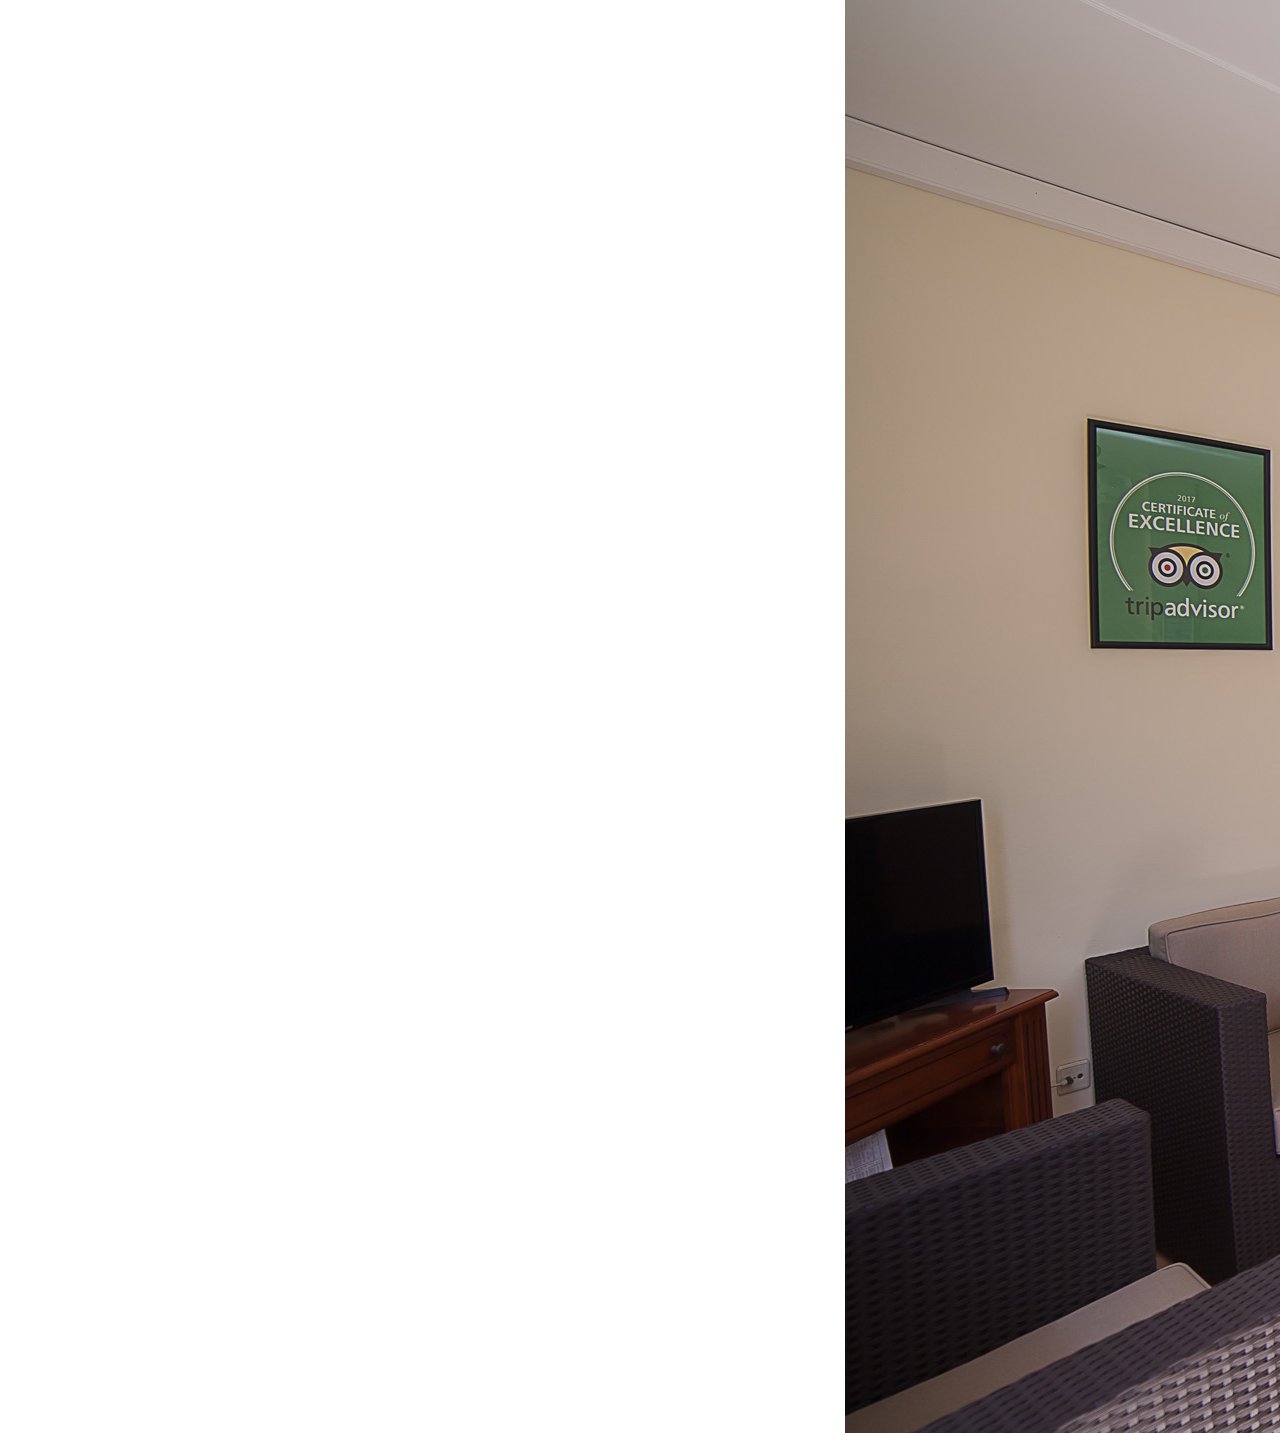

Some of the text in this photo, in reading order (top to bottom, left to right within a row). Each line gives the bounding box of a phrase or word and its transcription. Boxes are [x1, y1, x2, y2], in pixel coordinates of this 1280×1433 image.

[1177, 494, 1197, 503] 2017
[1141, 501, 1231, 522] CERTIFICATE of
[1128, 513, 1241, 539] EXCELLENCE
[1125, 596, 1239, 621] tripadvisor
